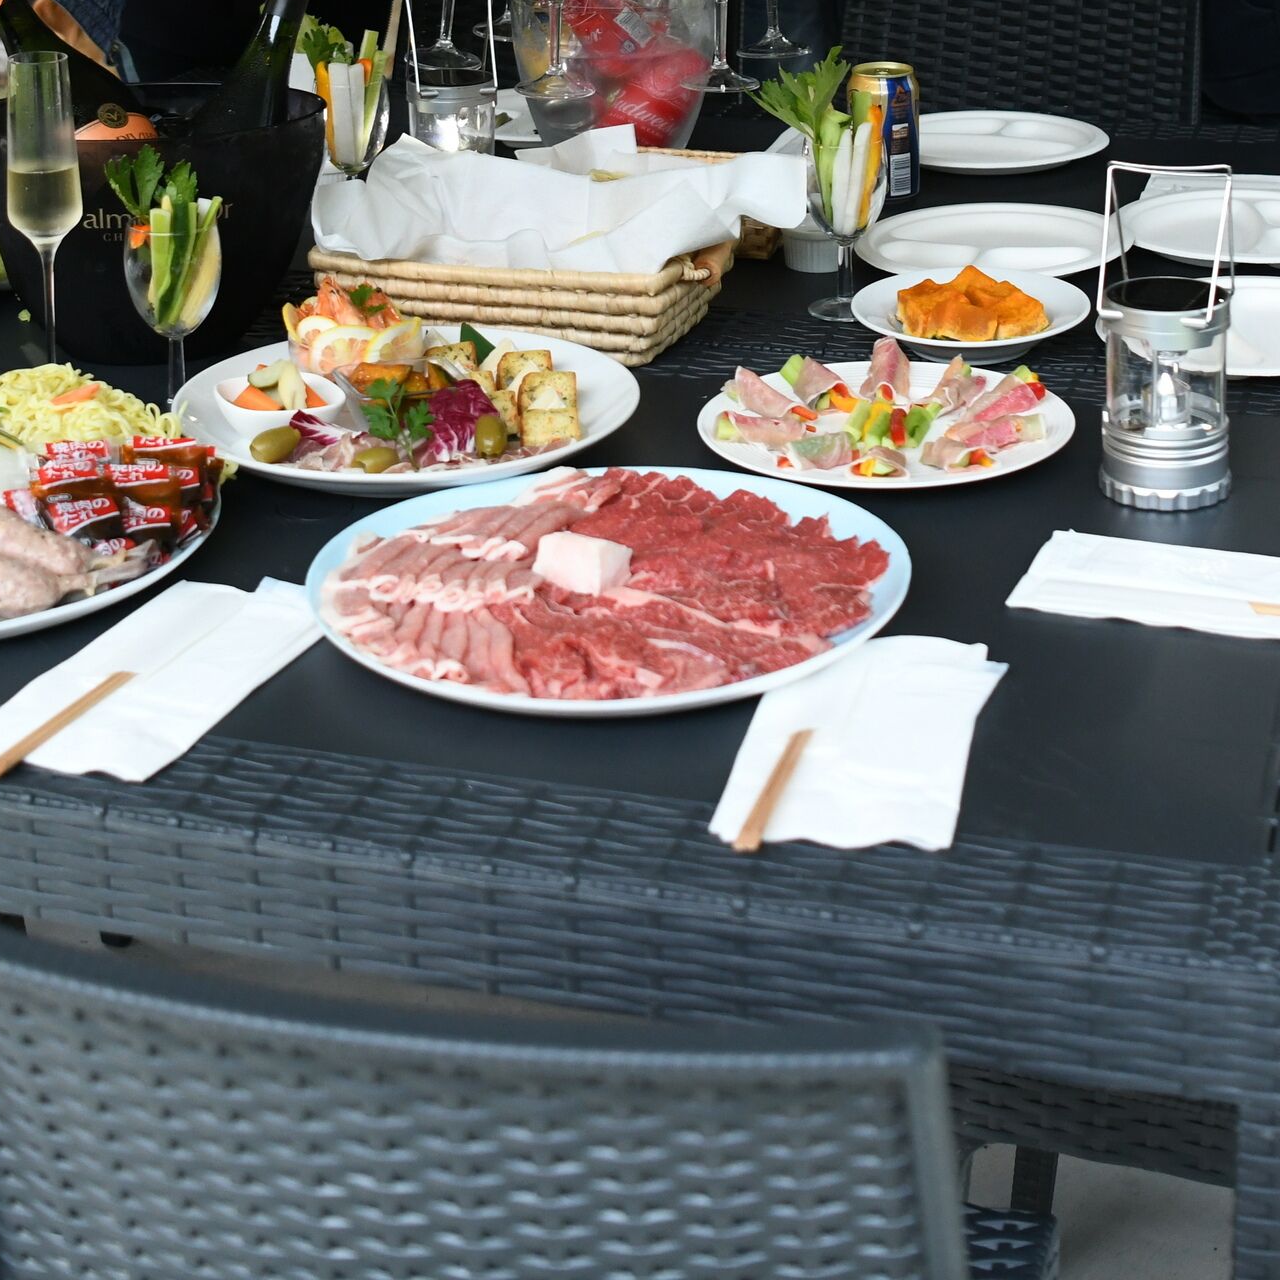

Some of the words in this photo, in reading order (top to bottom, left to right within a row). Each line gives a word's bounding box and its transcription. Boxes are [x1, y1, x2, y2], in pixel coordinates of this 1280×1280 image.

[56, 497, 110, 513] 焼肉の
[58, 510, 98, 527] たれ
